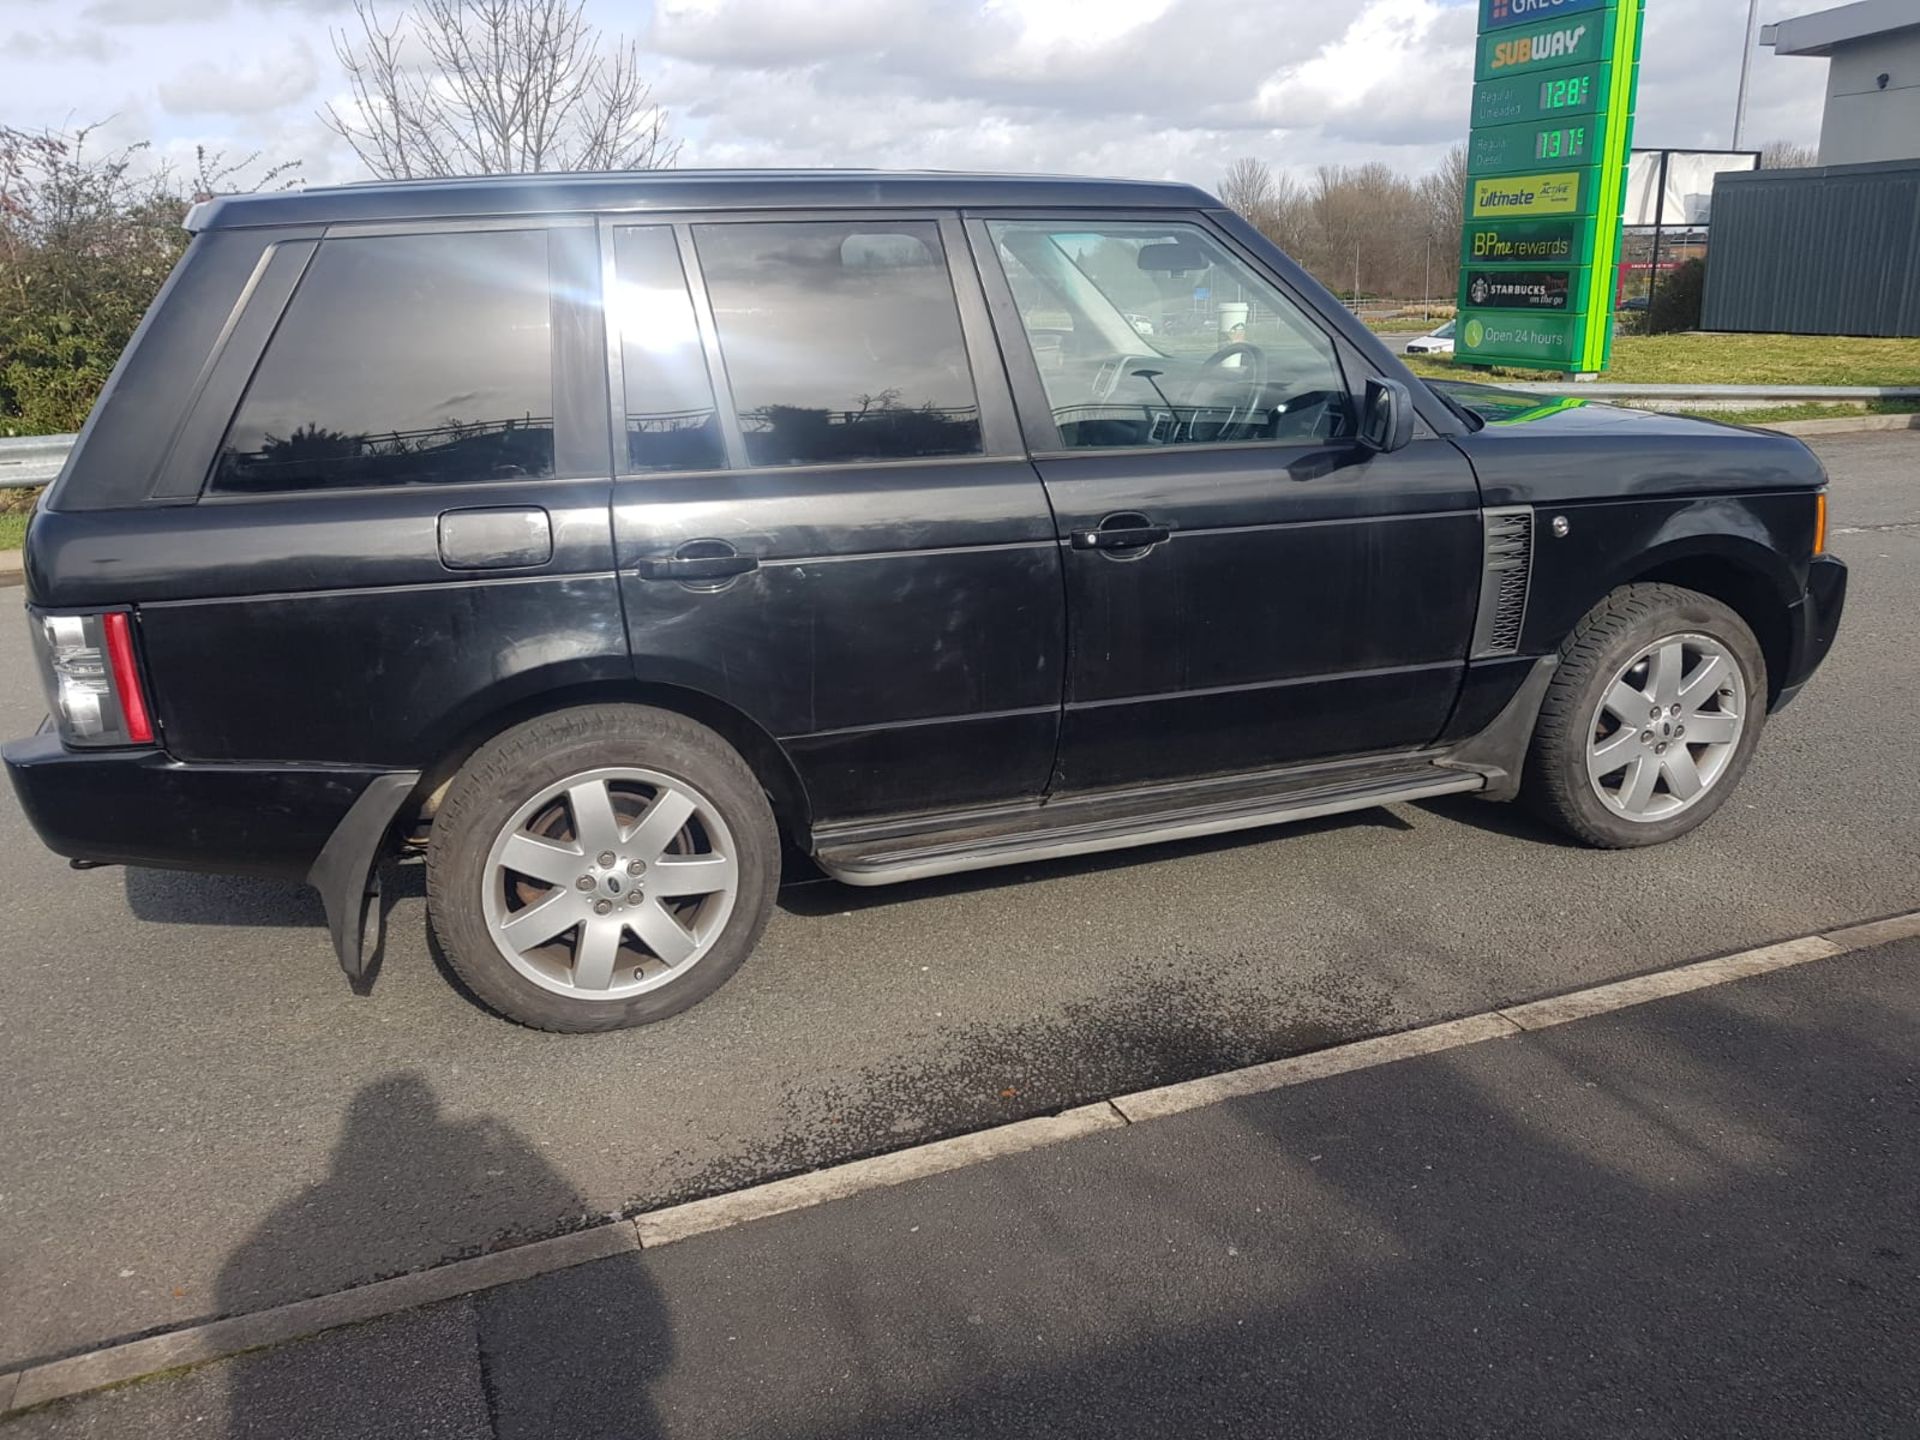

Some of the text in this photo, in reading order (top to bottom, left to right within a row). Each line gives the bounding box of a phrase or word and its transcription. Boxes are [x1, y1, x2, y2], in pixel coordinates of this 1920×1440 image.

[1492, 26, 1586, 68] SUBWAY
[1480, 189, 1535, 207] ultimate
[1513, 236, 1569, 256] rewards
[1490, 284, 1546, 295] STARBUCKS
[1553, 296, 1563, 306] go
[1485, 327, 1564, 345] Open 24 hours
